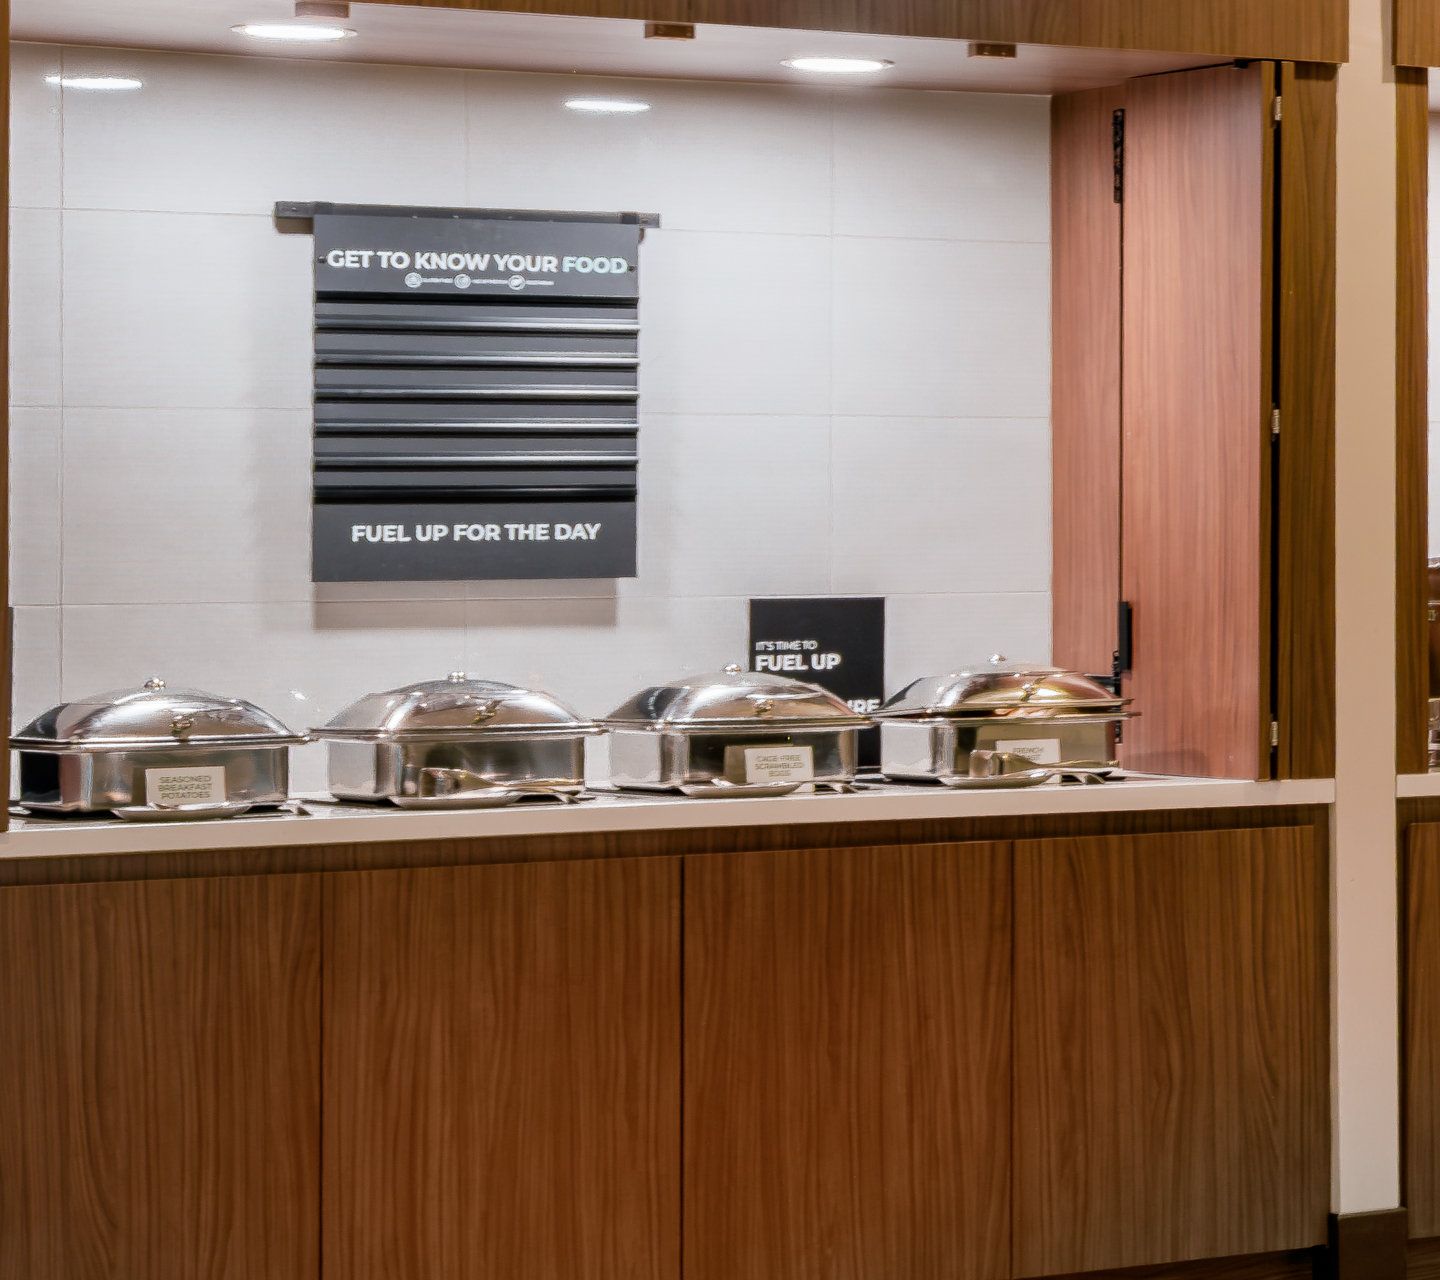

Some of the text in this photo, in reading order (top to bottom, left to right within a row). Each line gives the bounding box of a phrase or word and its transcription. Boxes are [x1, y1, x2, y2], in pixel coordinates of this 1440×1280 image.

[327, 250, 629, 274] GET TO KNOW YOUR FOOD
[352, 522, 602, 543] FUEL UP FOR THE DAY
[802, 640, 818, 650] TO
[755, 653, 841, 671] FUEL UP
